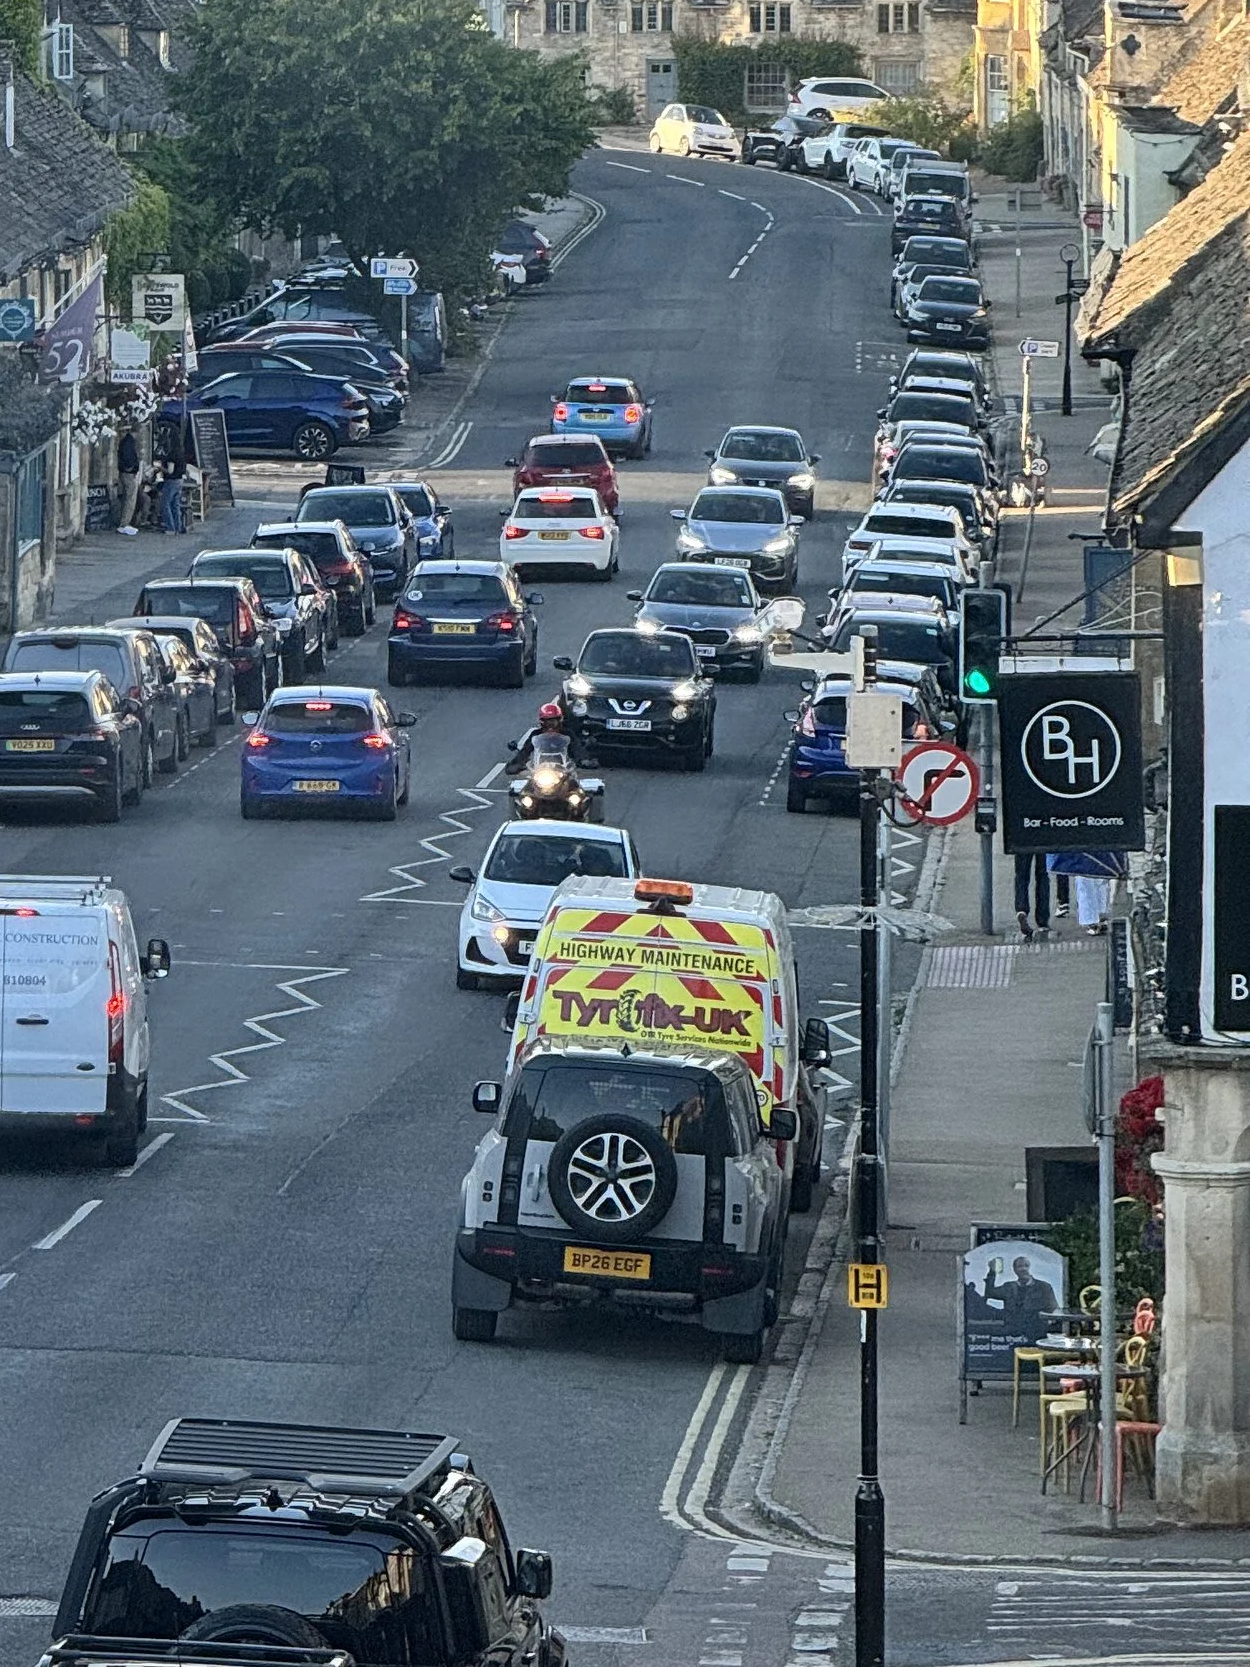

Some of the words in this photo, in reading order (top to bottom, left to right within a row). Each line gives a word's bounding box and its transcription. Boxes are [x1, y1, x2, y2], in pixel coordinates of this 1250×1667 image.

[113, 373, 148, 381] AKUBRA
[1032, 462, 1047, 472] 20
[1023, 818, 1042, 827] Bar
[1050, 817, 1079, 827] Food
[1087, 816, 1125, 826] Rooms
[4, 934, 98, 946] CONSTRUCTION
[560, 942, 637, 962] HIGHWAY
[641, 950, 755, 974] MAINTENANCE
[675, 1033, 707, 1045] Services
[708, 1036, 752, 1048] Nationwide
[571, 1253, 610, 1269] BP26
[613, 1257, 644, 1272] EGF
[854, 1268, 881, 1304] H
[968, 1344, 990, 1352] good
